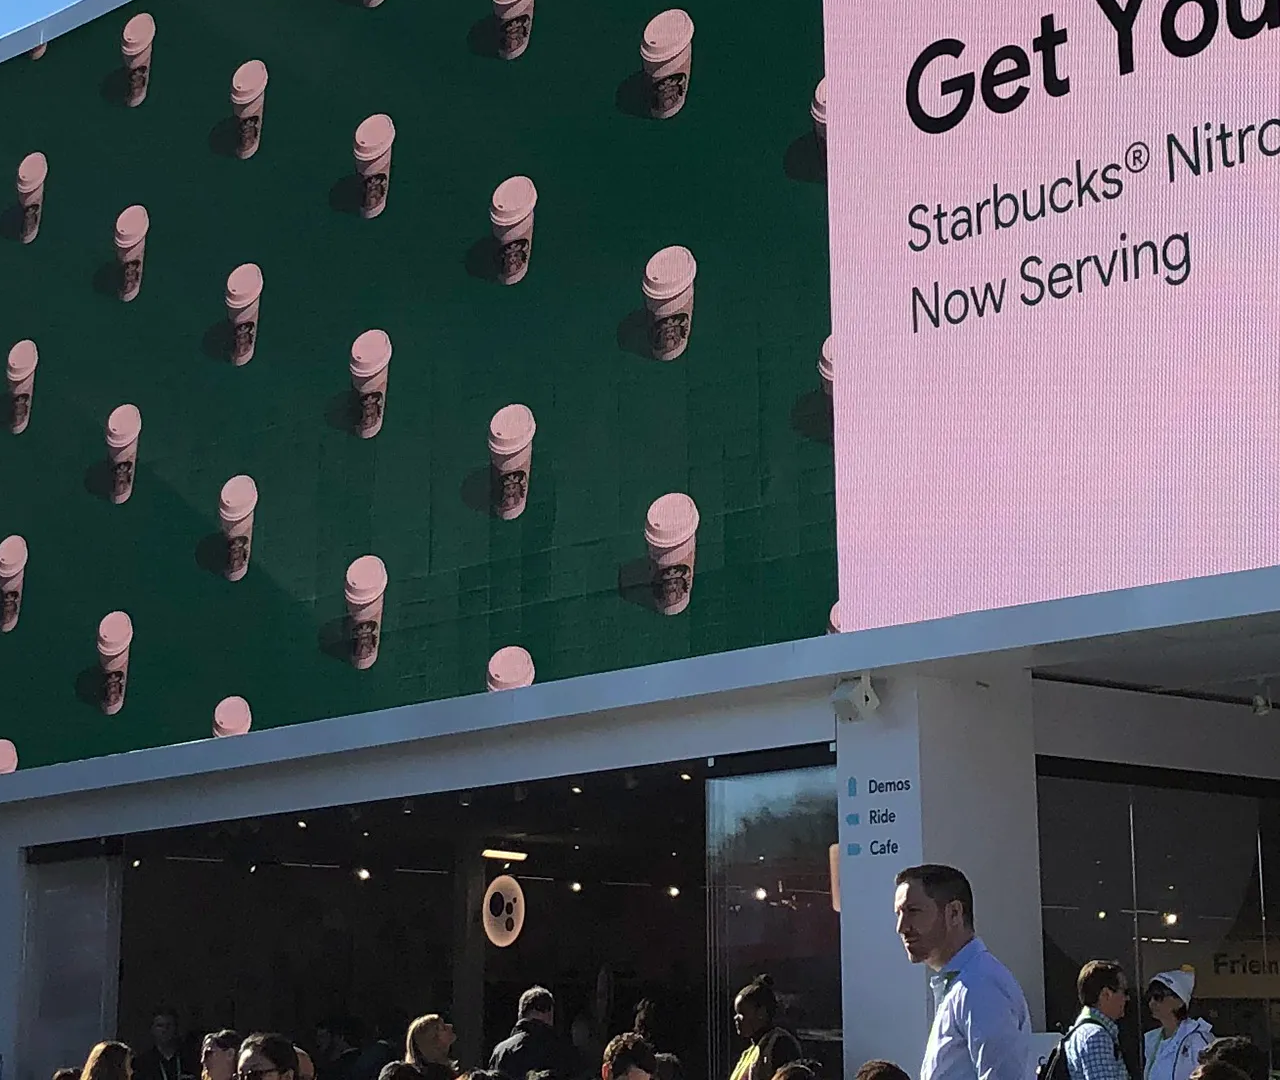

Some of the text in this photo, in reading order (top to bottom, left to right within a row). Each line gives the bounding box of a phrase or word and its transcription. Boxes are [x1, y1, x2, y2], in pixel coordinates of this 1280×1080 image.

[904, 12, 1071, 134] Get
[911, 230, 1193, 334] Now Serving
[868, 778, 911, 794] Demos
[869, 808, 897, 825] Ride
[869, 839, 899, 856] Cafe
